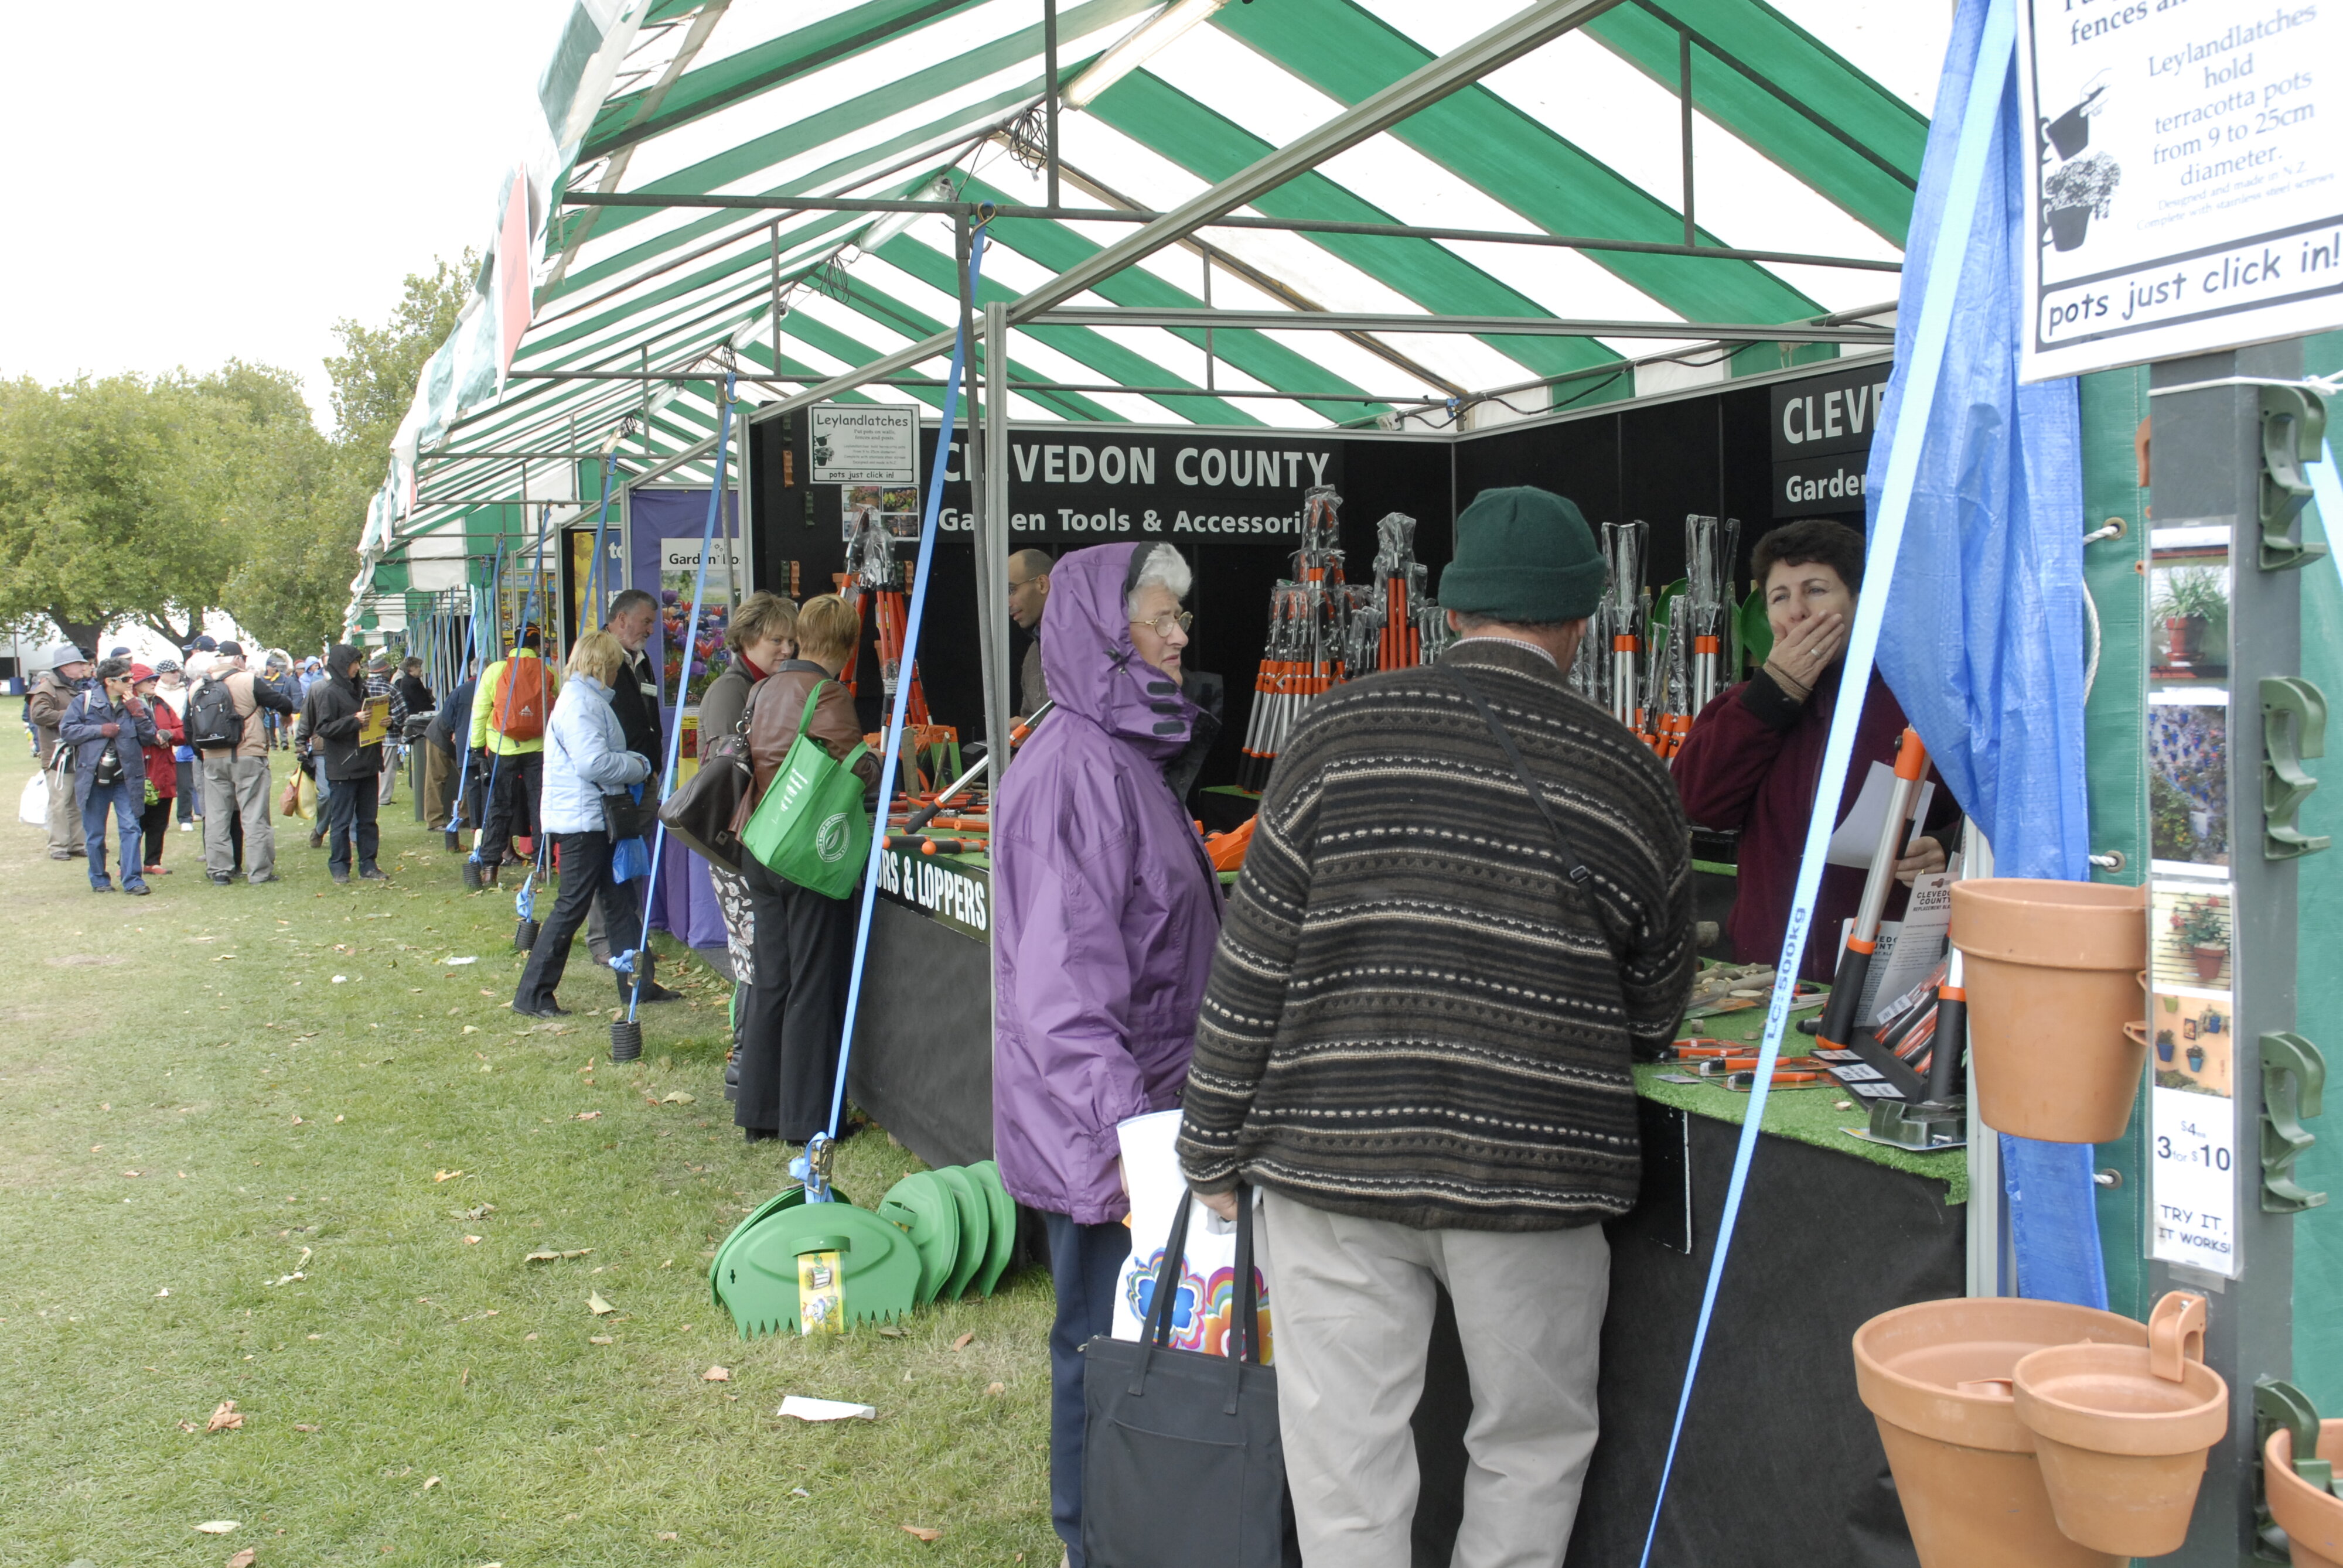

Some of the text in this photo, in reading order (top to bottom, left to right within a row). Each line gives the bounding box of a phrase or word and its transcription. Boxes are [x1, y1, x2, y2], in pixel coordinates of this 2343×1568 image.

[2071, 1, 2148, 46] fences
[2148, 4, 2318, 77] Leylandlatches
[2204, 52, 2254, 88] hold
[2155, 71, 2313, 134] terracotta pots
[2153, 103, 2315, 165] from 9 to 25cm
[2181, 146, 2282, 186] diameter.
[2137, 212, 2185, 231] Complete
[2189, 203, 2212, 217] with
[2216, 191, 2262, 210] stainless
[2266, 181, 2290, 197] steel
[2158, 189, 2206, 211] Designed
[2211, 182, 2229, 197] and
[2234, 175, 2264, 190] made
[2048, 232, 2341, 337] pots just click in!
[817, 414, 908, 428] Leylandlatches
[848, 472, 863, 480] just
[944, 442, 1329, 487] CLVEDON COUNTY
[939, 508, 1300, 534] Gaen Tools & Accessori
[669, 553, 716, 565] Gardn
[903, 856, 915, 901] &
[917, 860, 986, 931] LOPPERS
[2160, 1204, 2193, 1224] TRY
[2158, 1227, 2231, 1254] IT WORKS!
